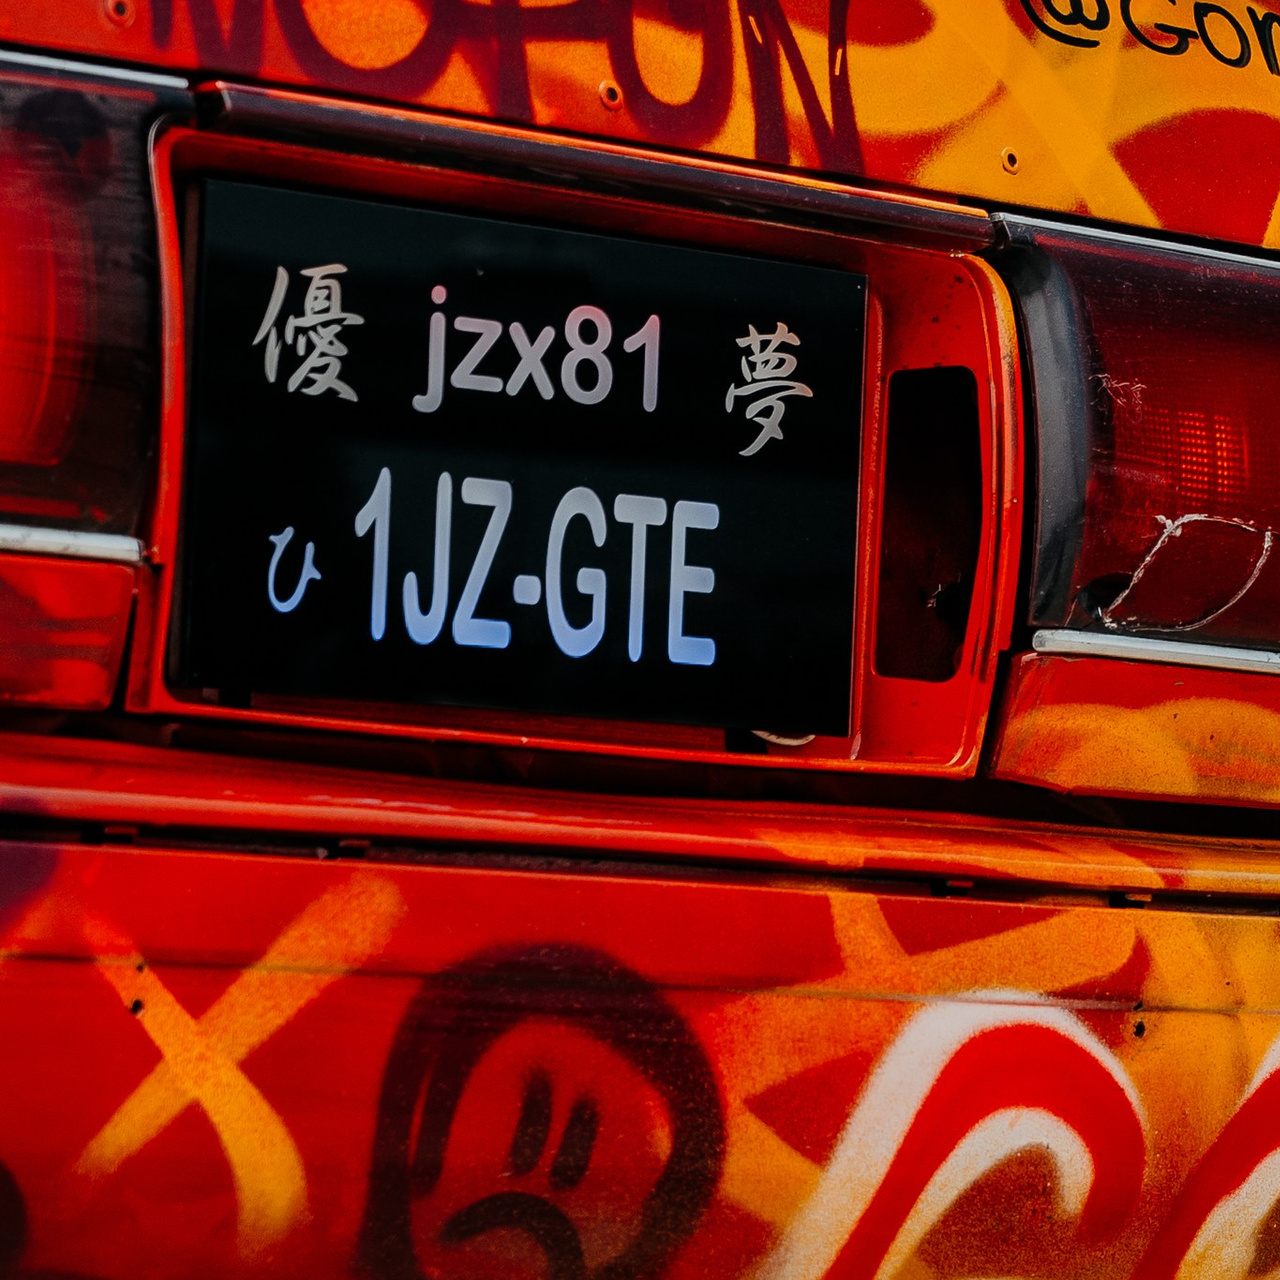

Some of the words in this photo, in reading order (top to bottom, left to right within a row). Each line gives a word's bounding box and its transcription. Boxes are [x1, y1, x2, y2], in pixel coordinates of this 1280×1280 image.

[252, 263, 365, 403] 優
[411, 285, 662, 413] jzx81
[725, 321, 814, 457] 夢
[267, 526, 322, 614] ひ
[354, 466, 721, 666] 1JZ-GTE
